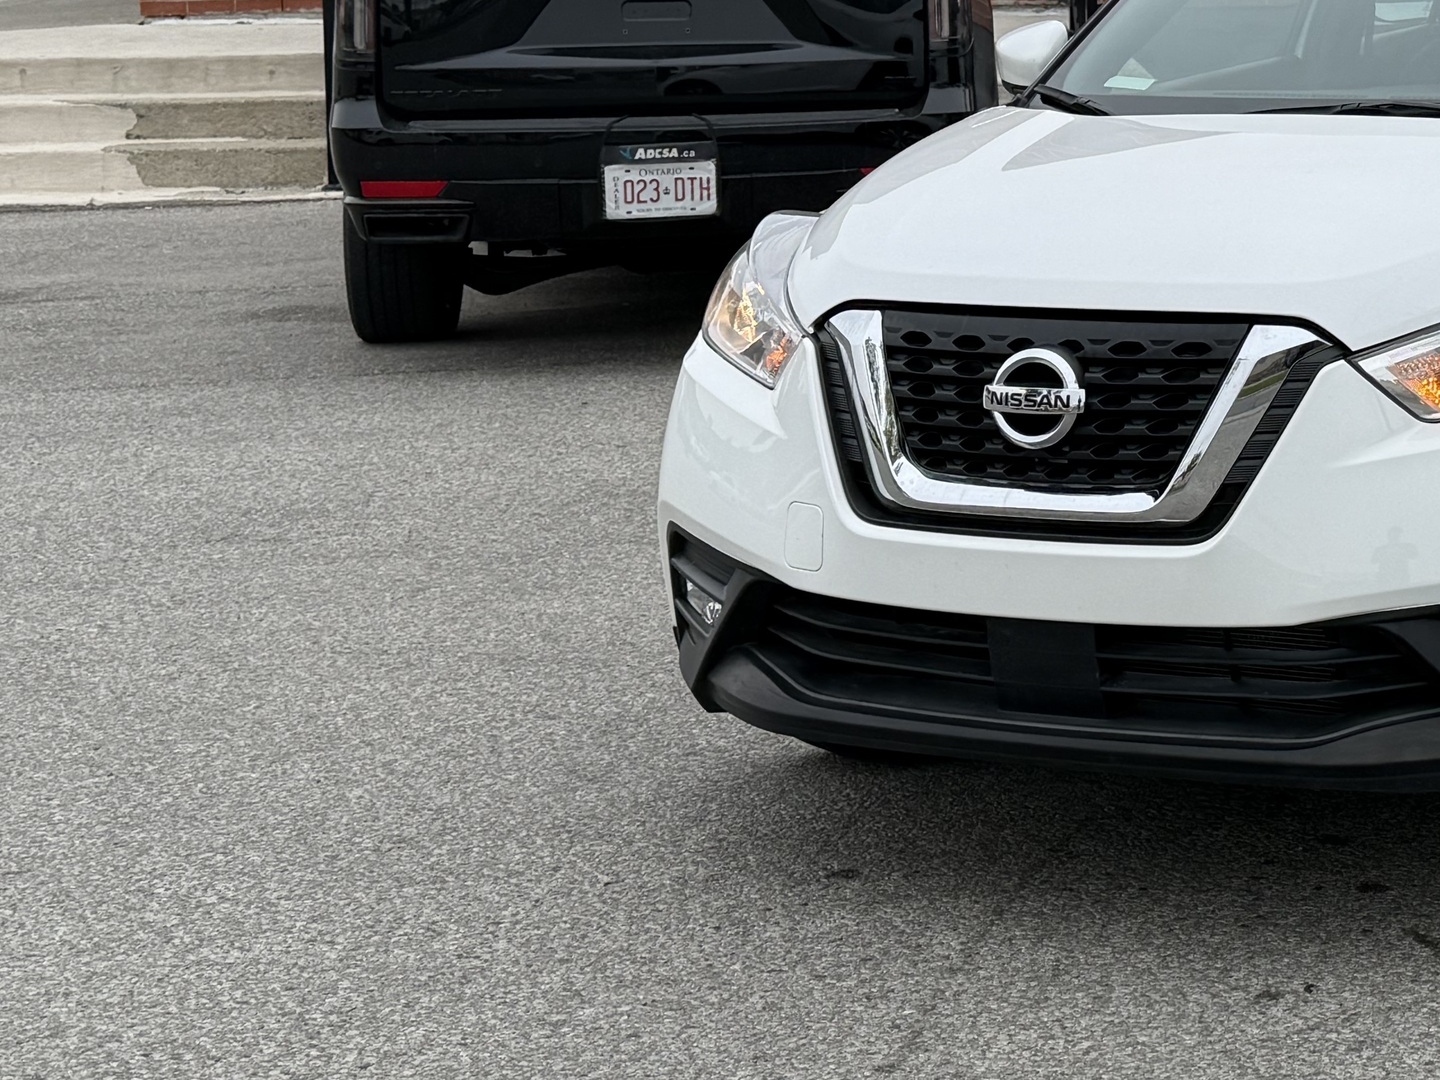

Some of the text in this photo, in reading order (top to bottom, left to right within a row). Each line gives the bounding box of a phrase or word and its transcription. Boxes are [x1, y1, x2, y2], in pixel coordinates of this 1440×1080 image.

[638, 168, 683, 177] ONTARIO
[623, 176, 711, 205] 023 DTH
[990, 391, 1071, 409] NISSAN
